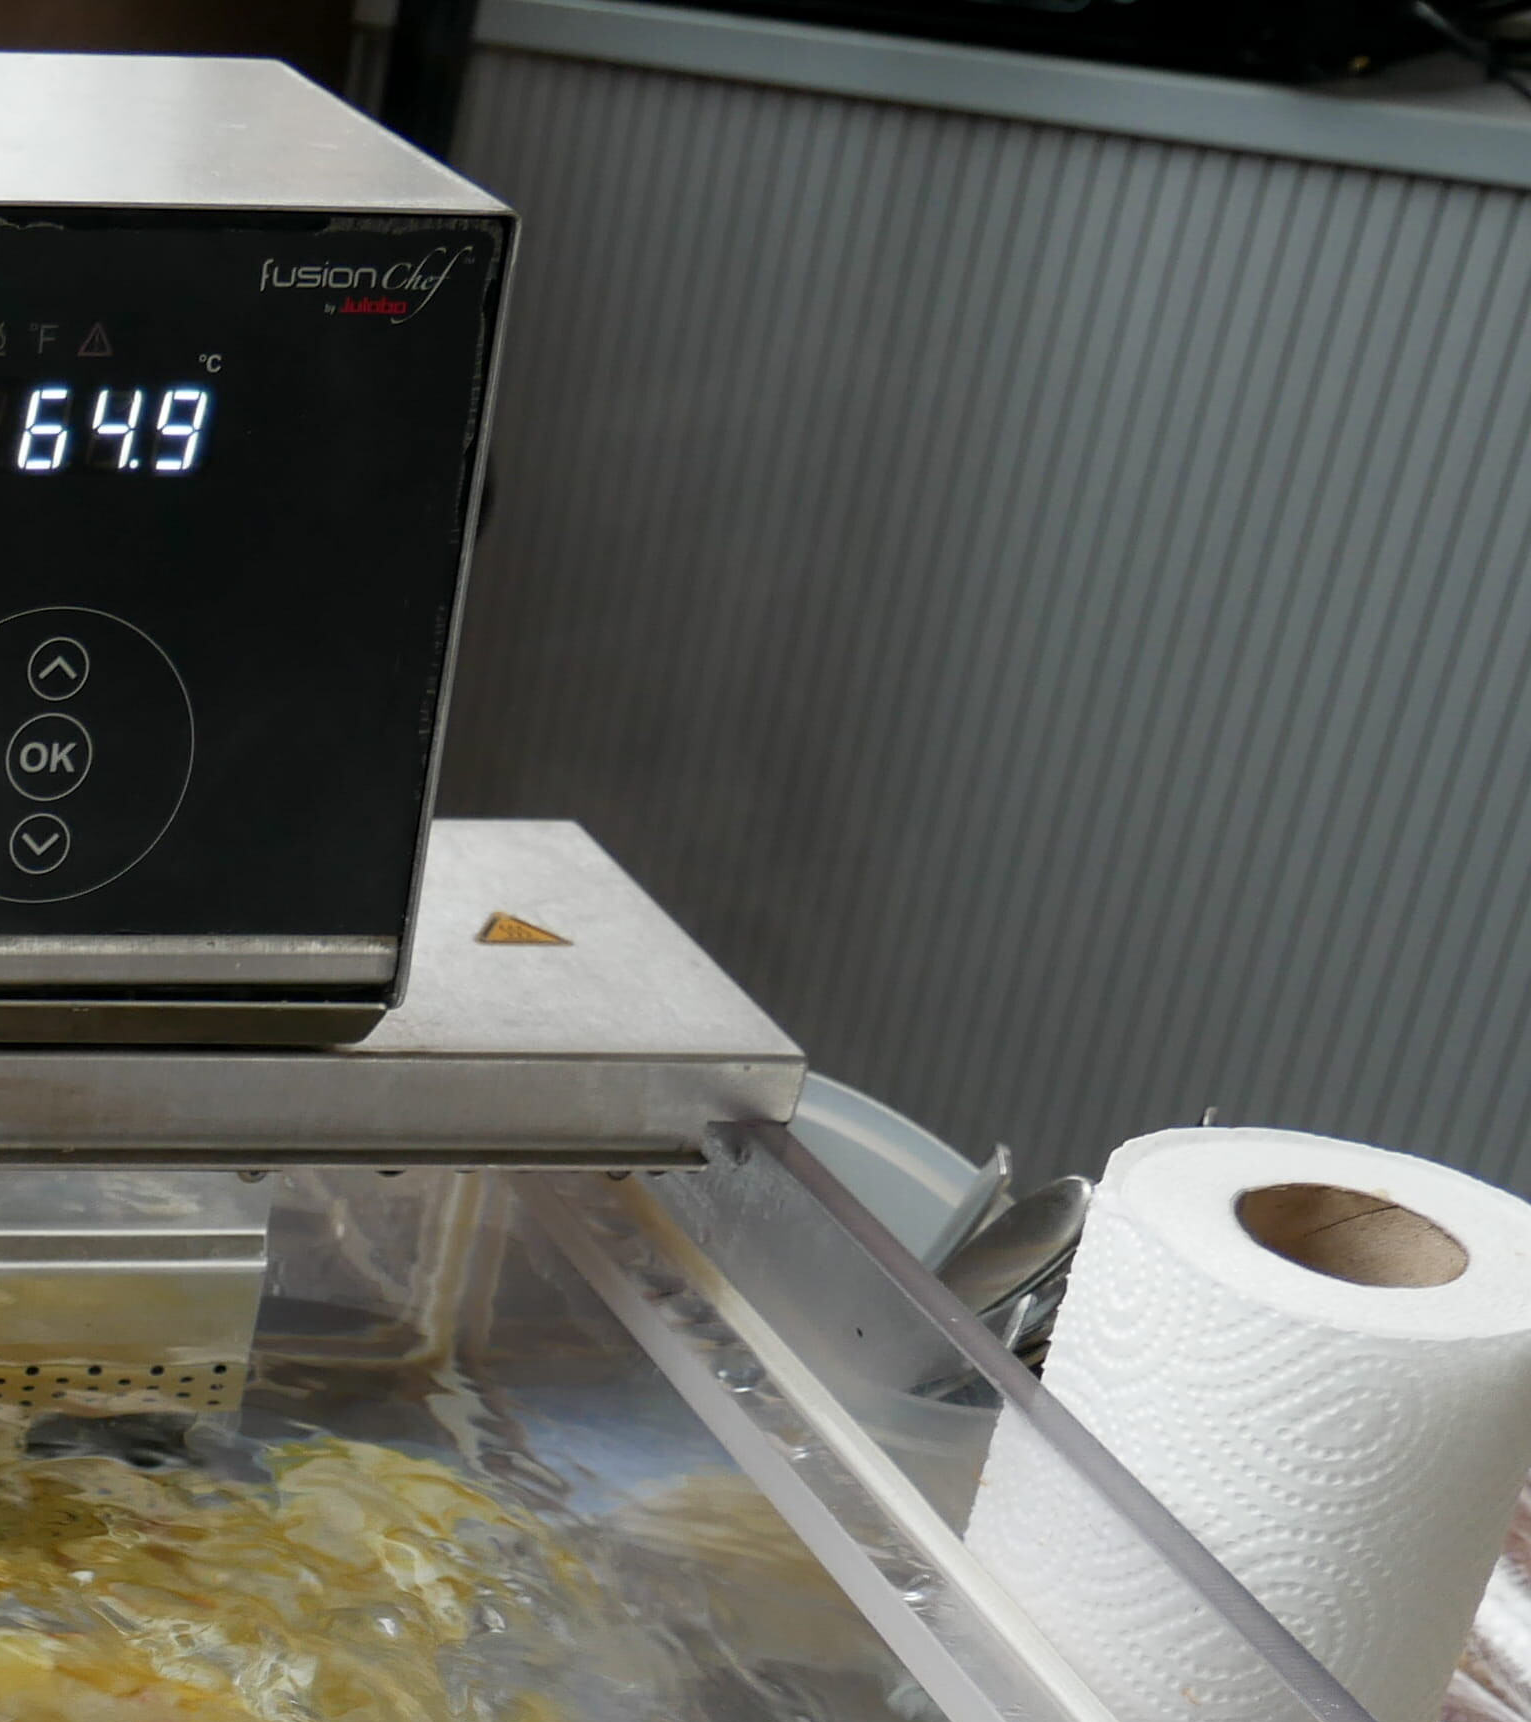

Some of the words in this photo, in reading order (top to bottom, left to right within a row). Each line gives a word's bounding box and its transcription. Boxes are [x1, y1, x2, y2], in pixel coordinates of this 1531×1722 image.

[259, 257, 377, 292] fusion
[381, 246, 474, 324] Chef
[324, 303, 336, 315] by
[339, 296, 409, 315] Julabo
[15, 387, 209, 472] 64.9
[18, 741, 76, 774] OK
